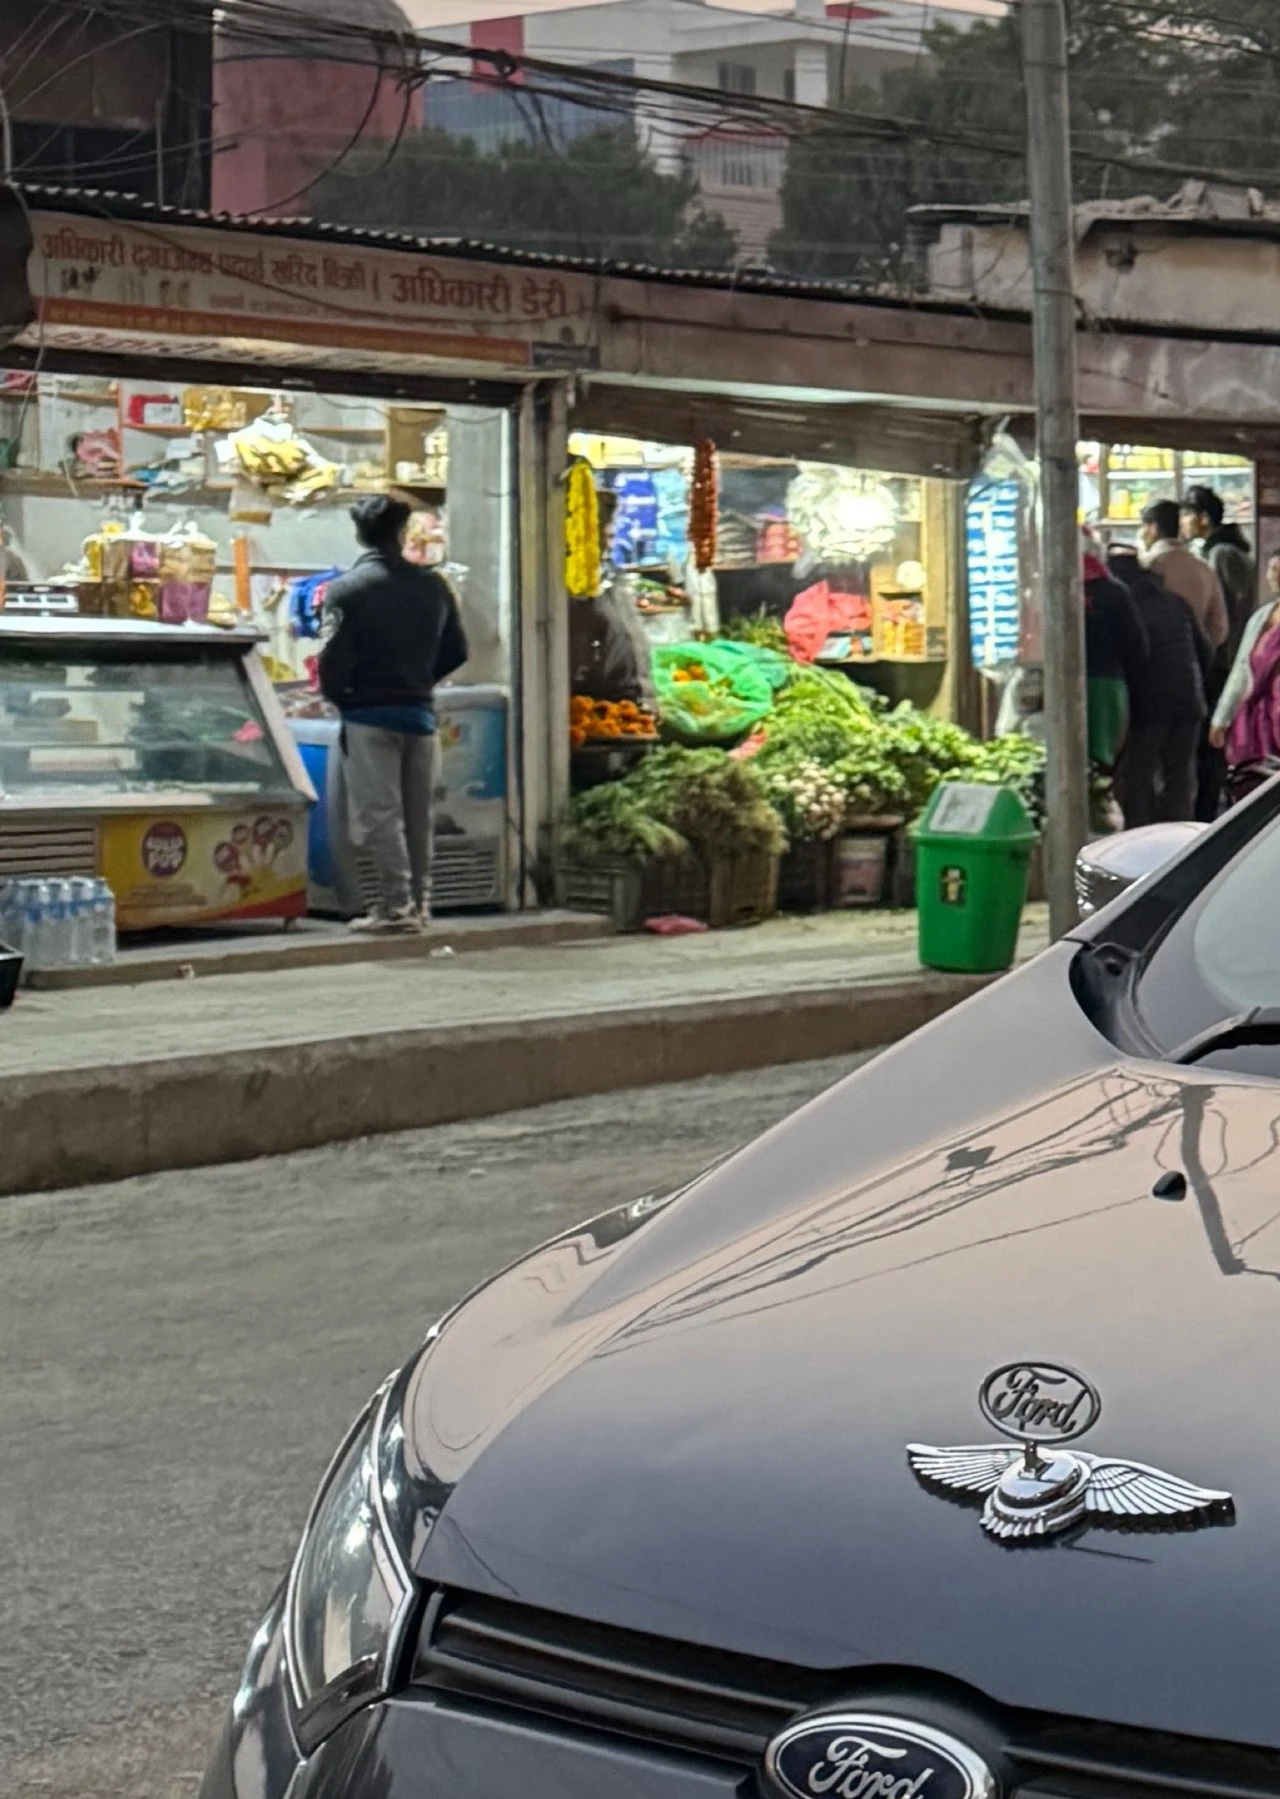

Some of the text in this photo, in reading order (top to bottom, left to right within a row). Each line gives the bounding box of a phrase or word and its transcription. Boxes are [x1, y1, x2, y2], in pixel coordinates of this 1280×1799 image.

[42, 226, 124, 267] अधिकारी
[390, 265, 511, 314] अधिकारी
[521, 276, 567, 319] डेरी
[992, 1366, 1085, 1434] Ford
